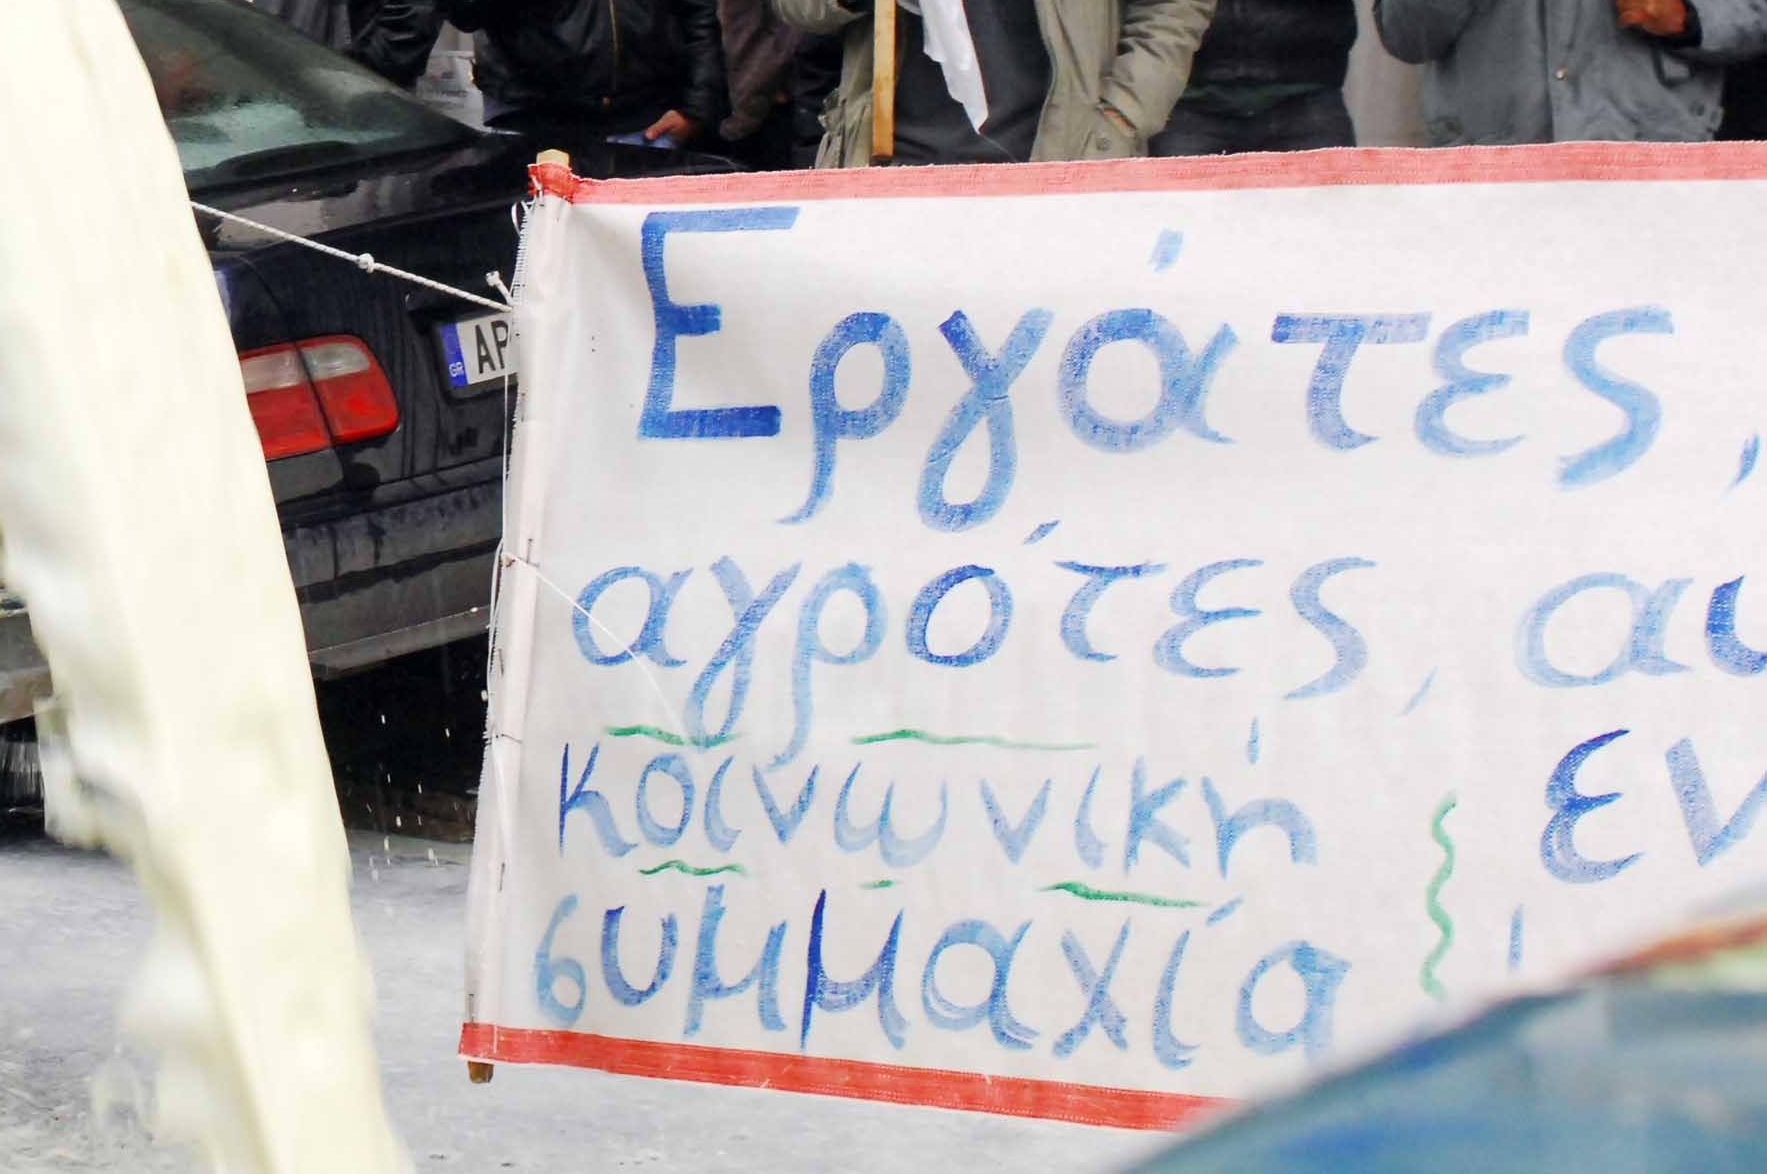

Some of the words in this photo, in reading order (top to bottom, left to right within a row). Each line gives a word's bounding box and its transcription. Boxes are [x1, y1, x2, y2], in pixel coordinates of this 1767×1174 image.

[449, 362, 464, 377] GR
[635, 206, 1761, 531] Εργάτες,
[570, 520, 1438, 769] αγρότες,
[558, 716, 1318, 878] κοινωνική
